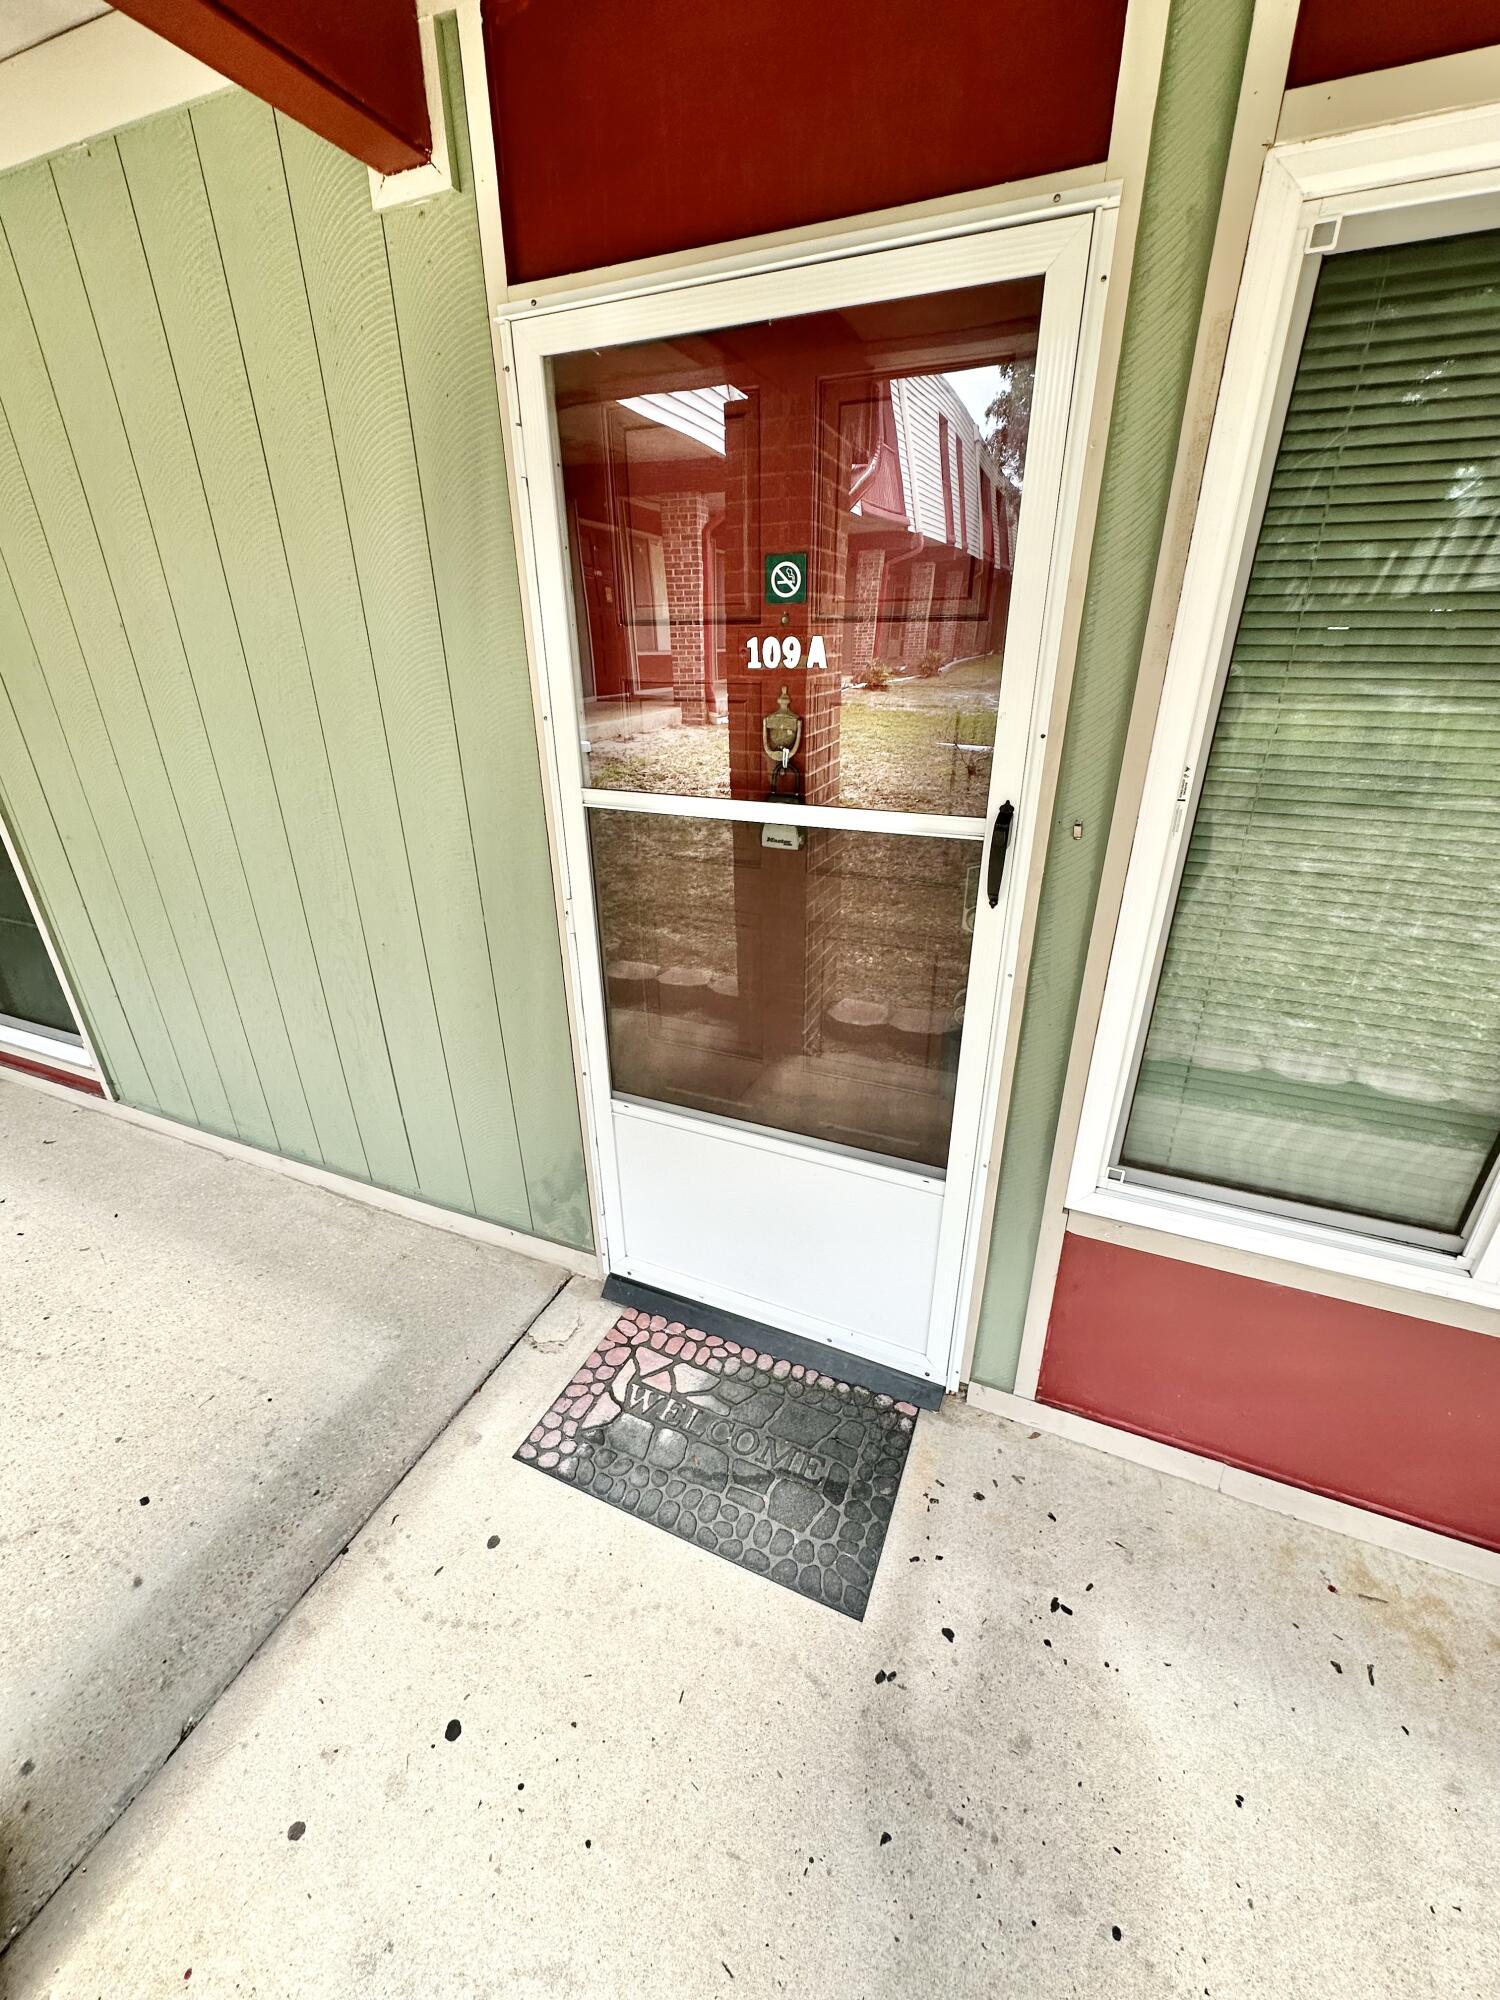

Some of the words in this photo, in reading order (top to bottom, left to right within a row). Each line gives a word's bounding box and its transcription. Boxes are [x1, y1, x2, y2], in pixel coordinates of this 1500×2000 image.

[746, 635, 801, 669] 109
[806, 635, 828, 669] A
[629, 1383, 827, 1485] WELCOME
